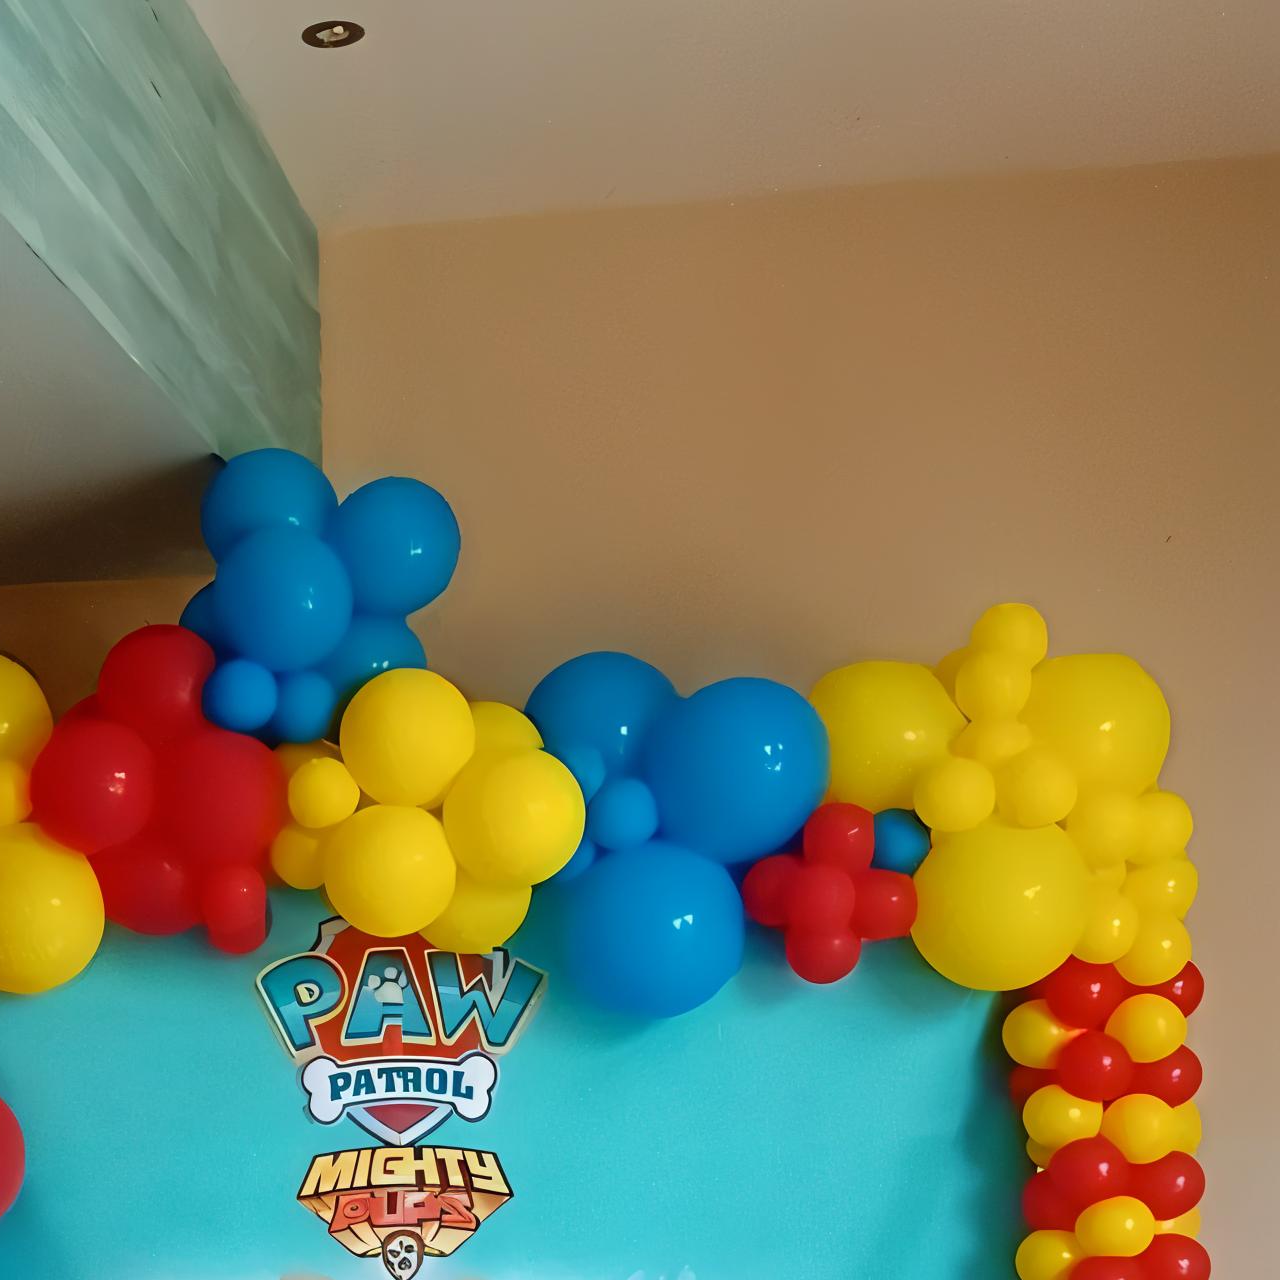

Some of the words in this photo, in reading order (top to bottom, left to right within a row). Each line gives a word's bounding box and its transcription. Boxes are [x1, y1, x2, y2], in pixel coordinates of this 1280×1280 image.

[257, 947, 548, 1057] PAW
[328, 1066, 475, 1101] PATROL
[299, 1147, 513, 1199] MIGHTY
[328, 1190, 481, 1233] PUPS
